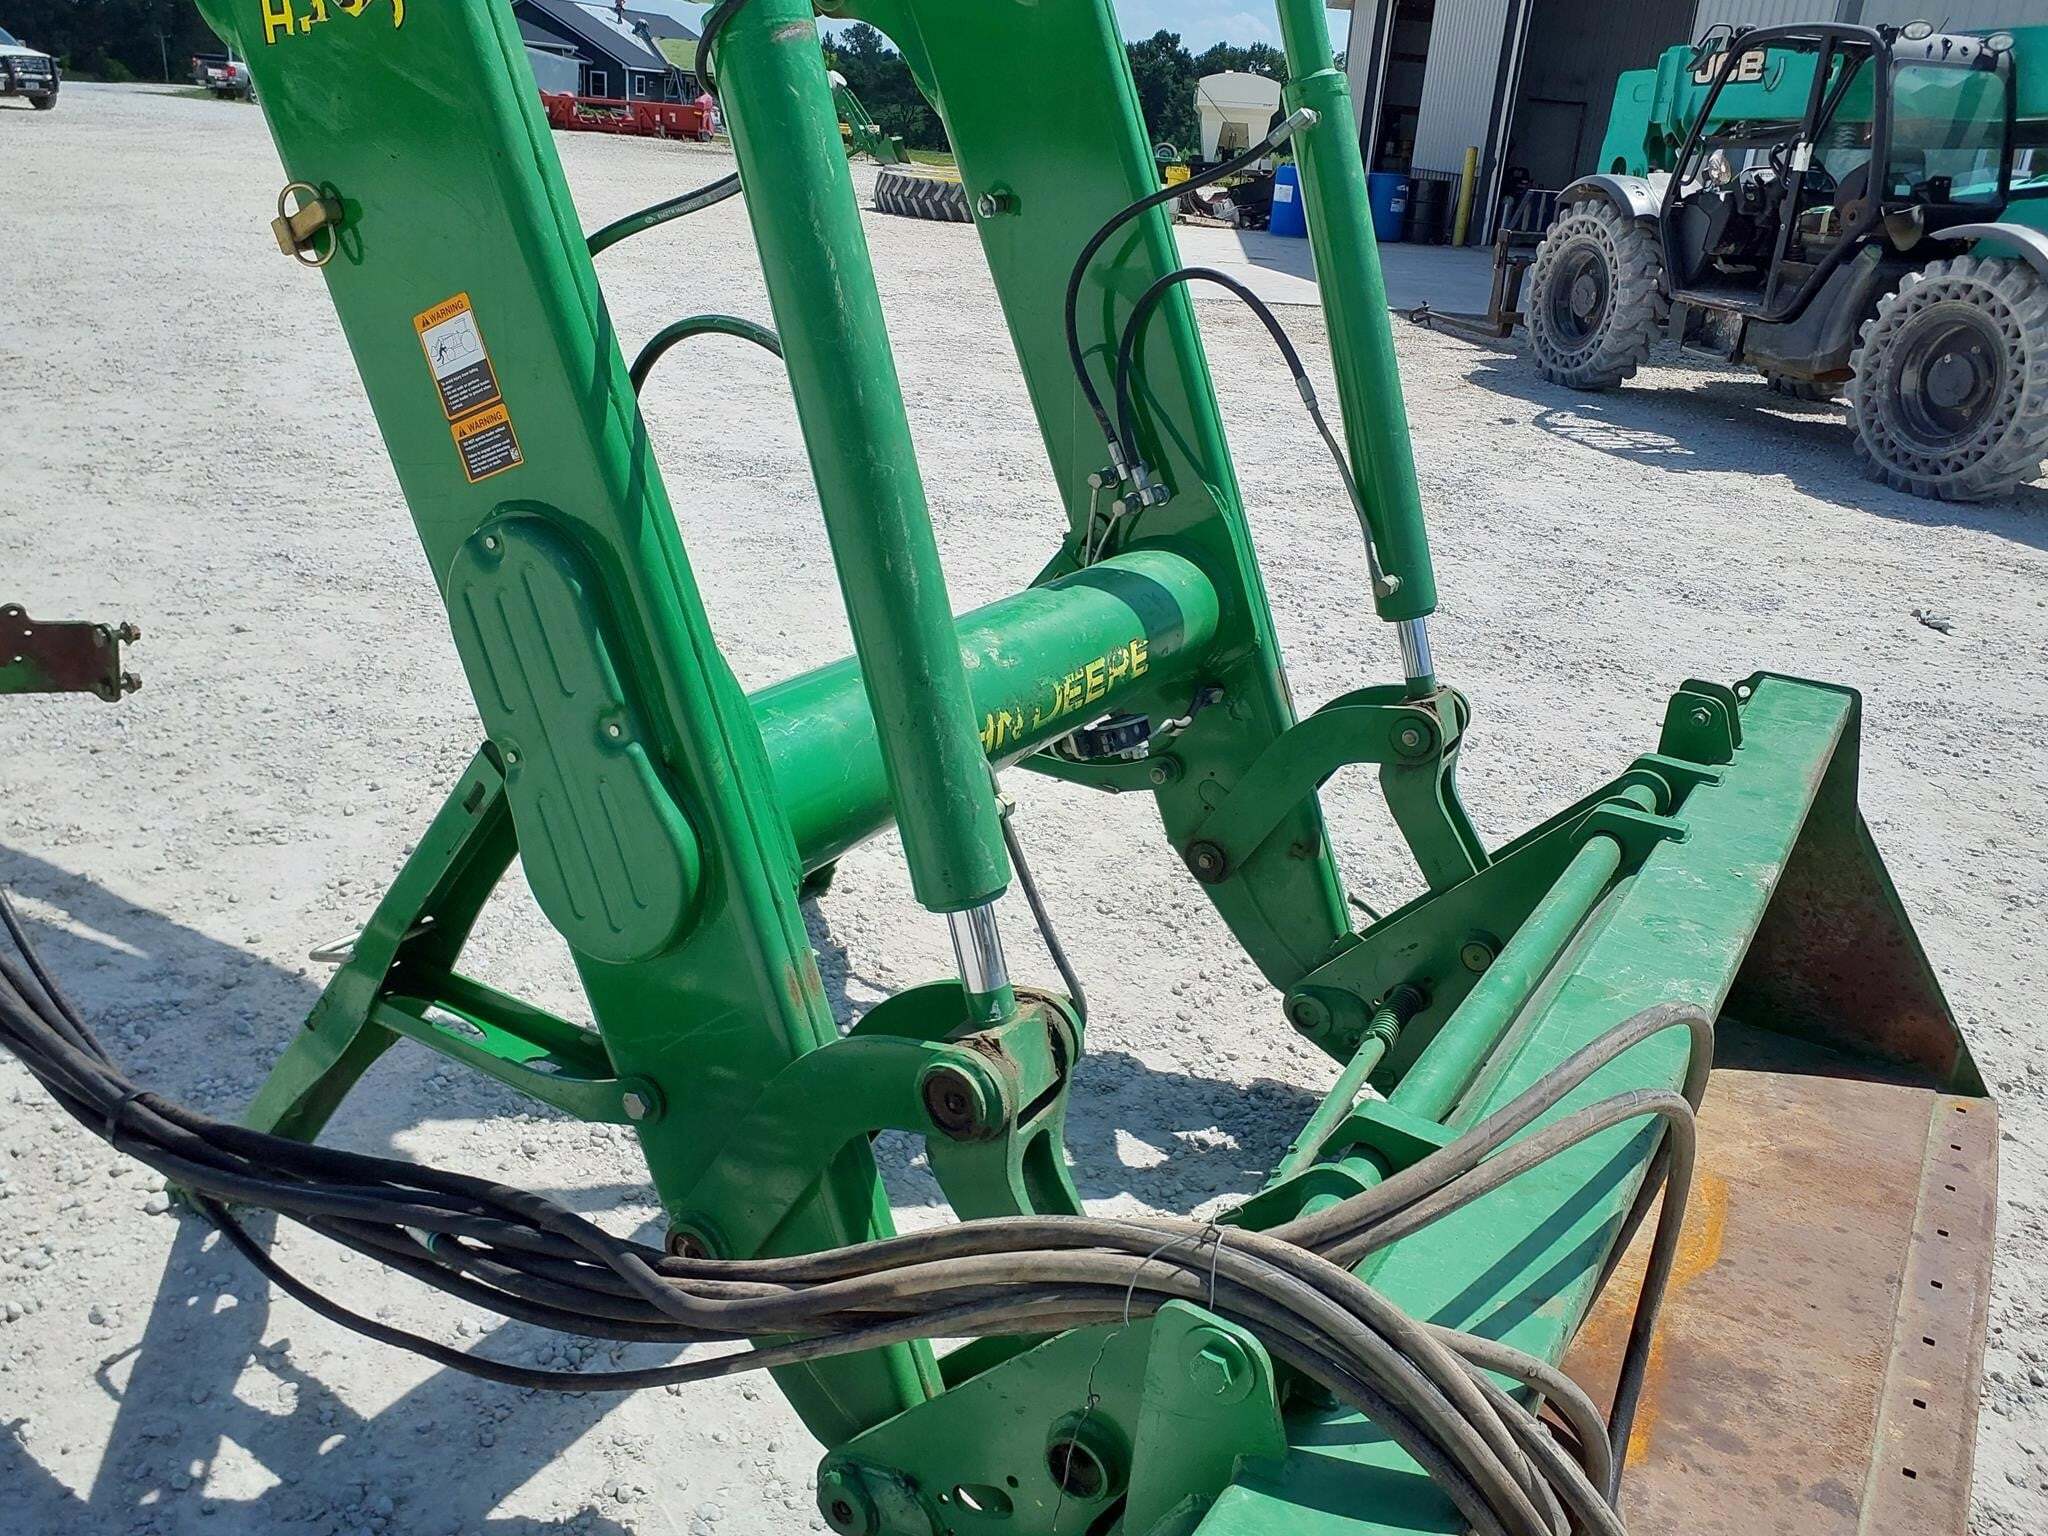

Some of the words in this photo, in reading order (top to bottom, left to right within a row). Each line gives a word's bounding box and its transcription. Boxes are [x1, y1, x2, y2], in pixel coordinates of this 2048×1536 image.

[1694, 50, 1765, 84] JCB
[429, 299, 464, 322] WARNING
[467, 411, 503, 432] WARNING
